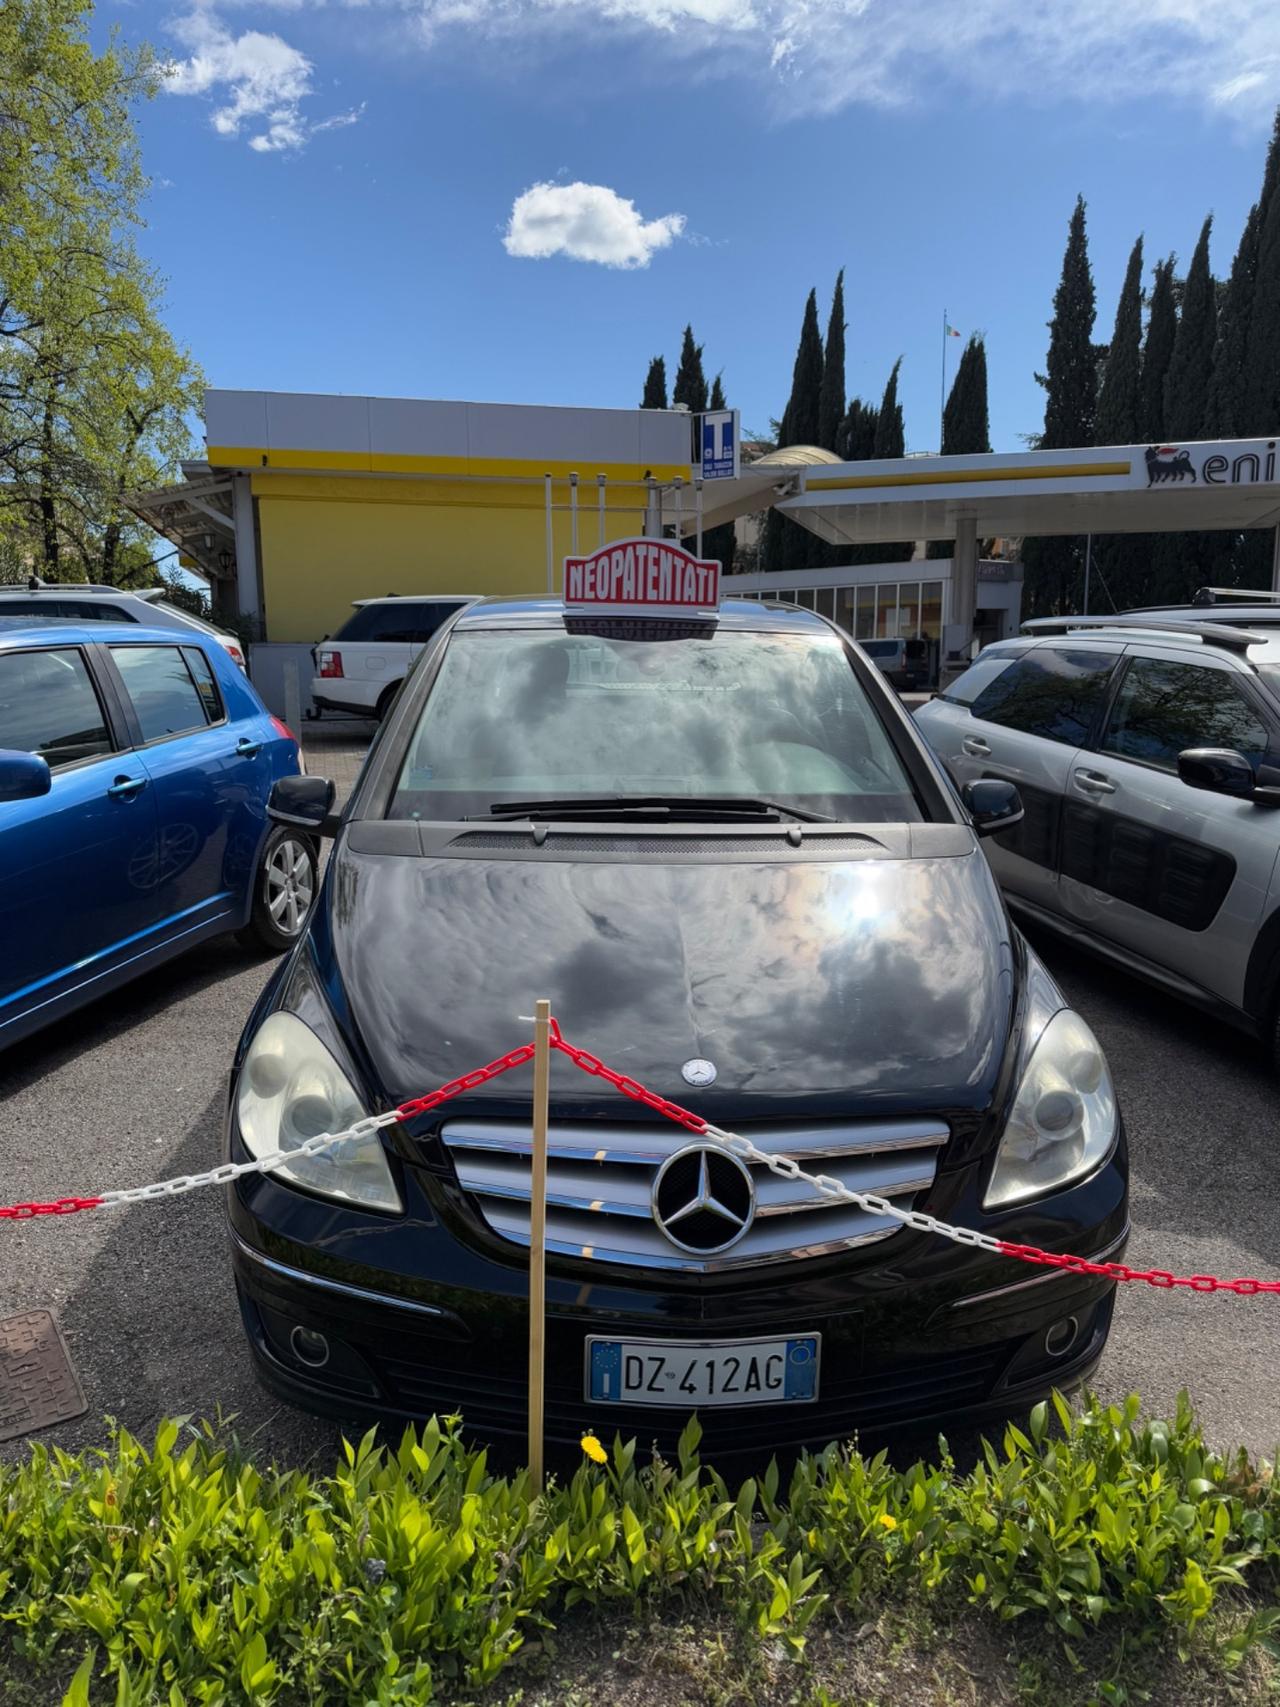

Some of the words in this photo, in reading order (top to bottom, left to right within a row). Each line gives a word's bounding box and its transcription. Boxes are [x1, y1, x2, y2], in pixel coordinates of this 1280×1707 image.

[705, 412, 732, 460] T
[1203, 441, 1276, 484] eni
[569, 544, 715, 603] NEOPATENTATI
